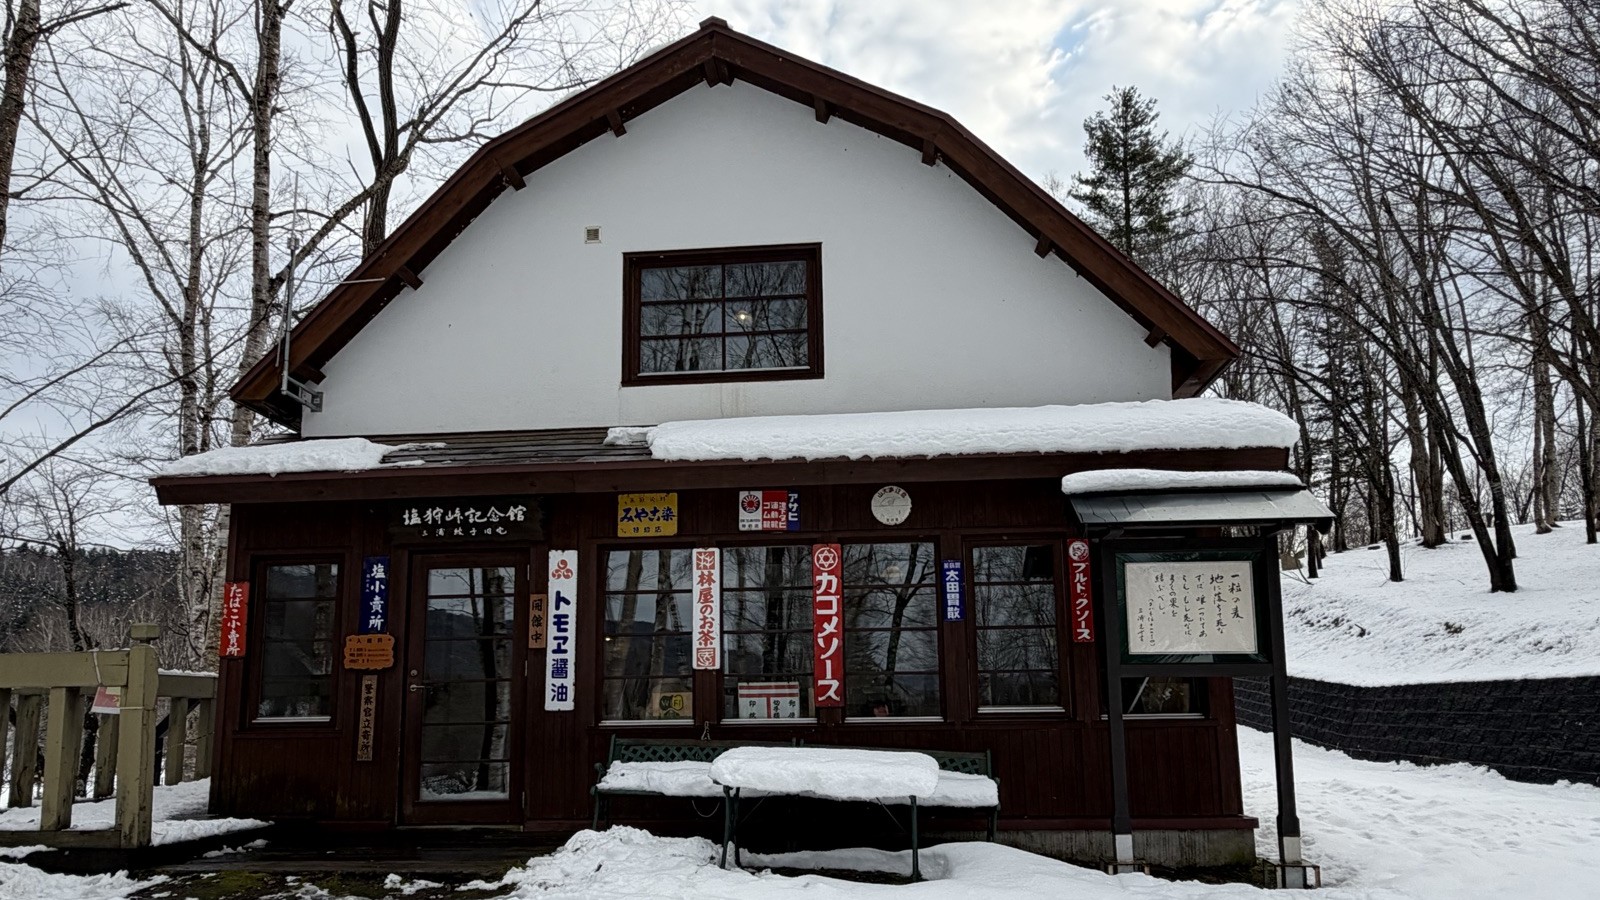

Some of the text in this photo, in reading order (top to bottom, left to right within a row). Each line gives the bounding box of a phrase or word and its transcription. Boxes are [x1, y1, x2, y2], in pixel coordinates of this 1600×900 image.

[403, 504, 527, 526] 塩狩峠記念館
[788, 493, 799, 521] アサヒ
[696, 570, 716, 647] 林屋のお茶
[816, 571, 840, 702] カゴメソース
[1072, 562, 1091, 640] ブルドックソース
[360, 683, 374, 753] 警察官立寄所
